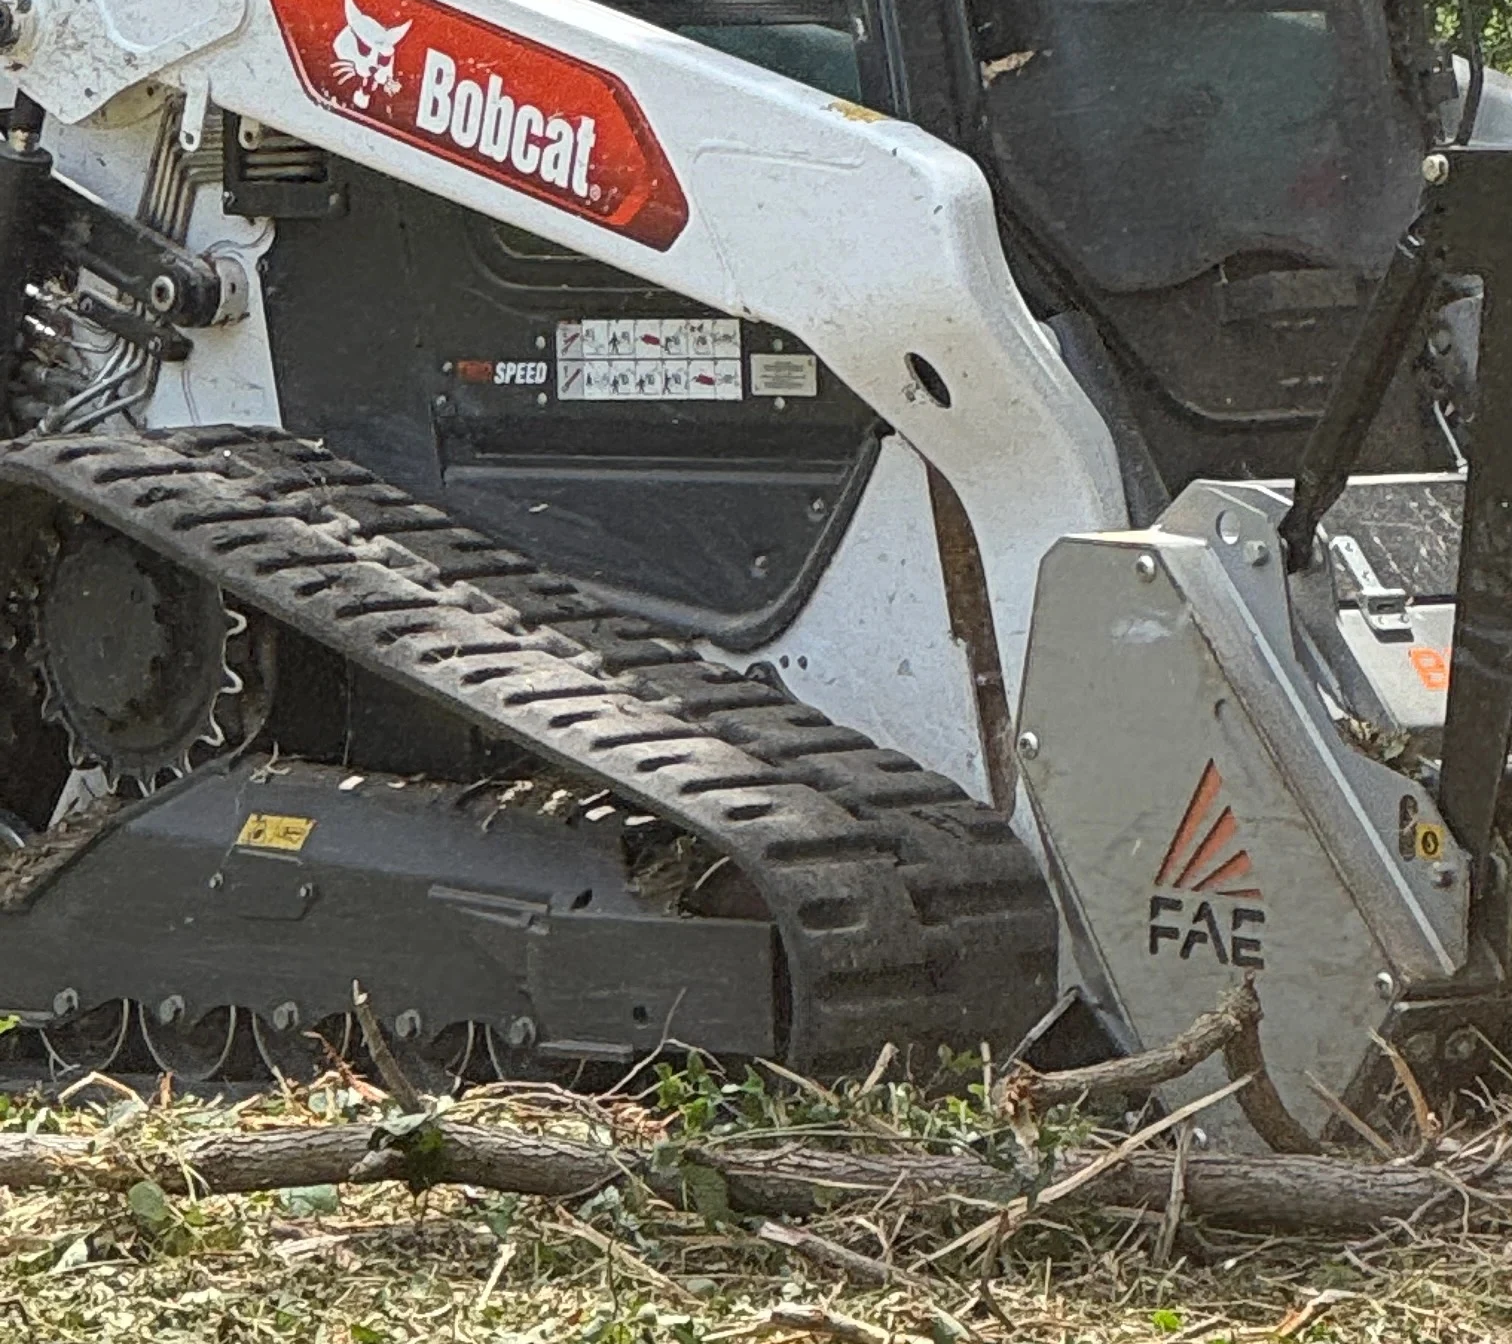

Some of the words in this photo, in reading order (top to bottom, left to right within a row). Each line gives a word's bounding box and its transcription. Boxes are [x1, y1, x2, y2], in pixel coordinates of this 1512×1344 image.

[416, 47, 596, 198] Bobcat
[493, 361, 548, 385] SPEED
[1149, 895, 1265, 970] FAE
